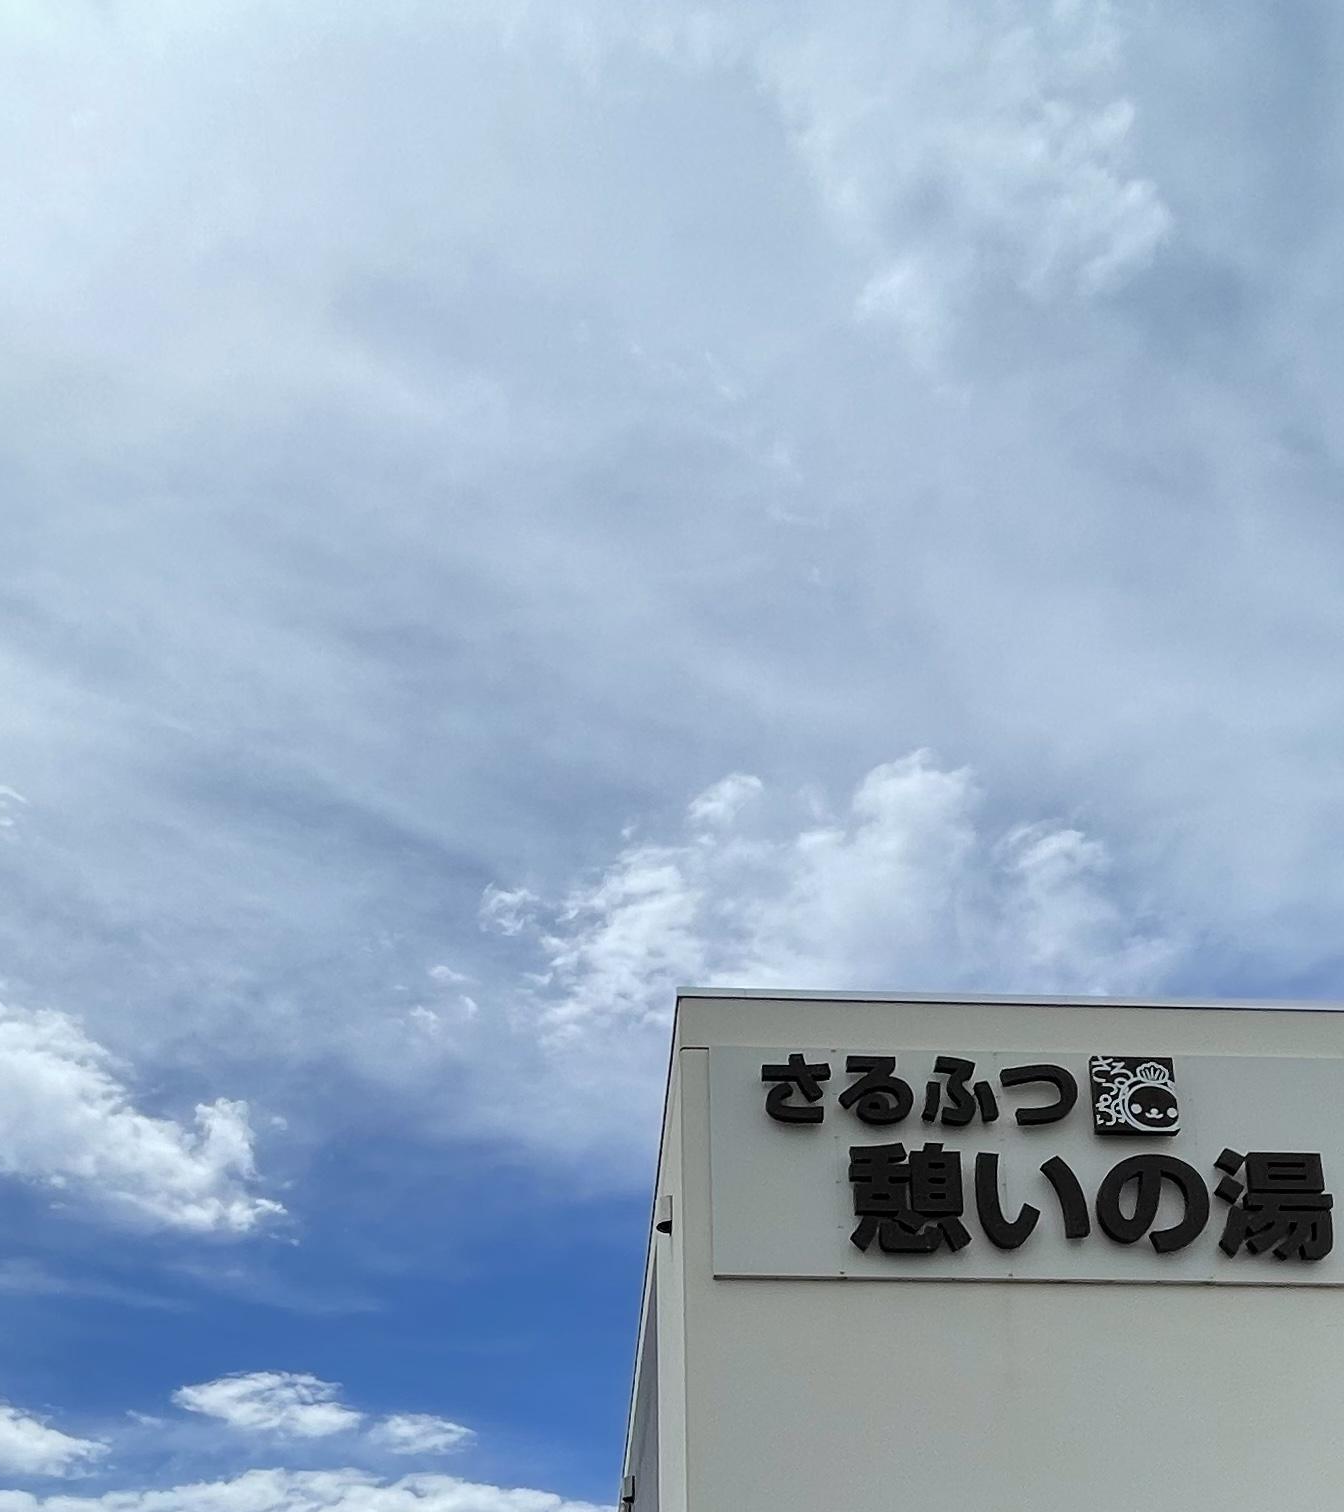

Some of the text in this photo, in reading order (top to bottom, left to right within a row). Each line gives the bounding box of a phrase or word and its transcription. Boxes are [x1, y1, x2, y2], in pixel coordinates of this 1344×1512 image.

[762, 1054, 1078, 1125] さるふつ
[849, 1143, 1333, 1261] 憩いの湯
